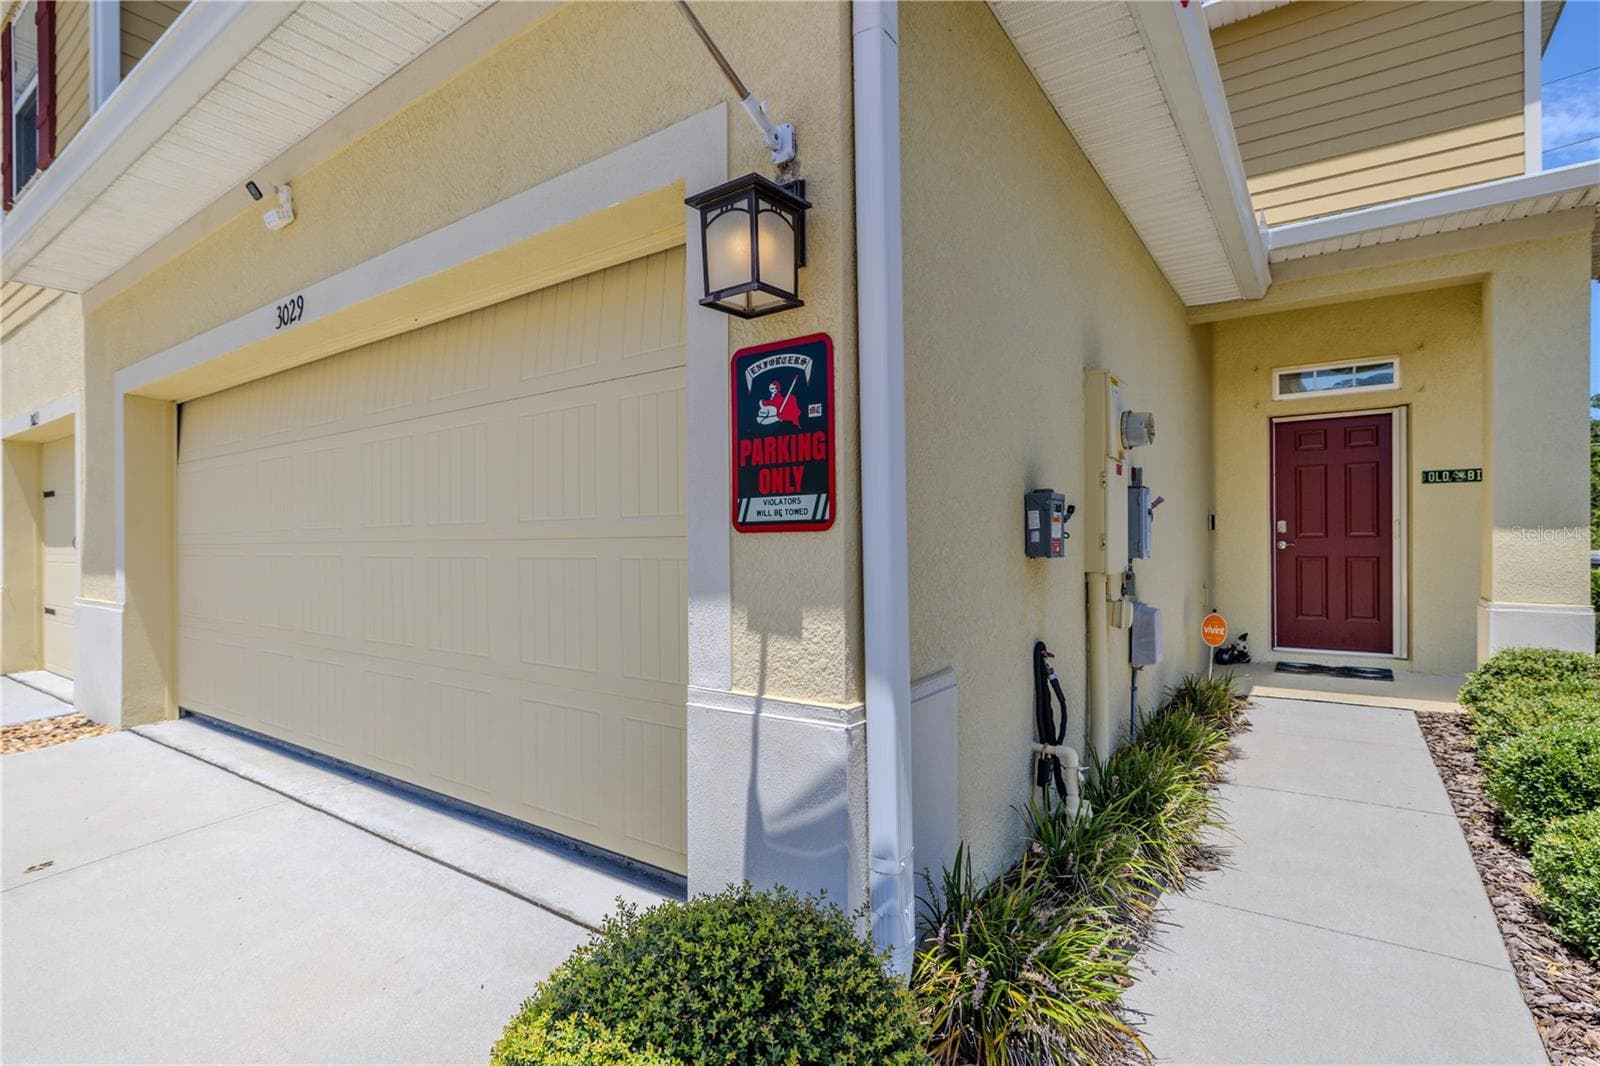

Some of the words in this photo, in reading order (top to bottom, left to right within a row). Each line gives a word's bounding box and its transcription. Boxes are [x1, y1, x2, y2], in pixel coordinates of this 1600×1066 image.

[275, 294, 304, 330] 3029
[750, 355, 807, 375] ENFORCERS
[740, 431, 826, 467] PARKING
[758, 466, 805, 495] ONLY
[762, 497, 802, 506] VIOLATORS
[756, 510, 771, 518] WILL
[773, 509, 782, 517] BE
[784, 508, 809, 516] TOWED
[1203, 624, 1225, 635] vivint
